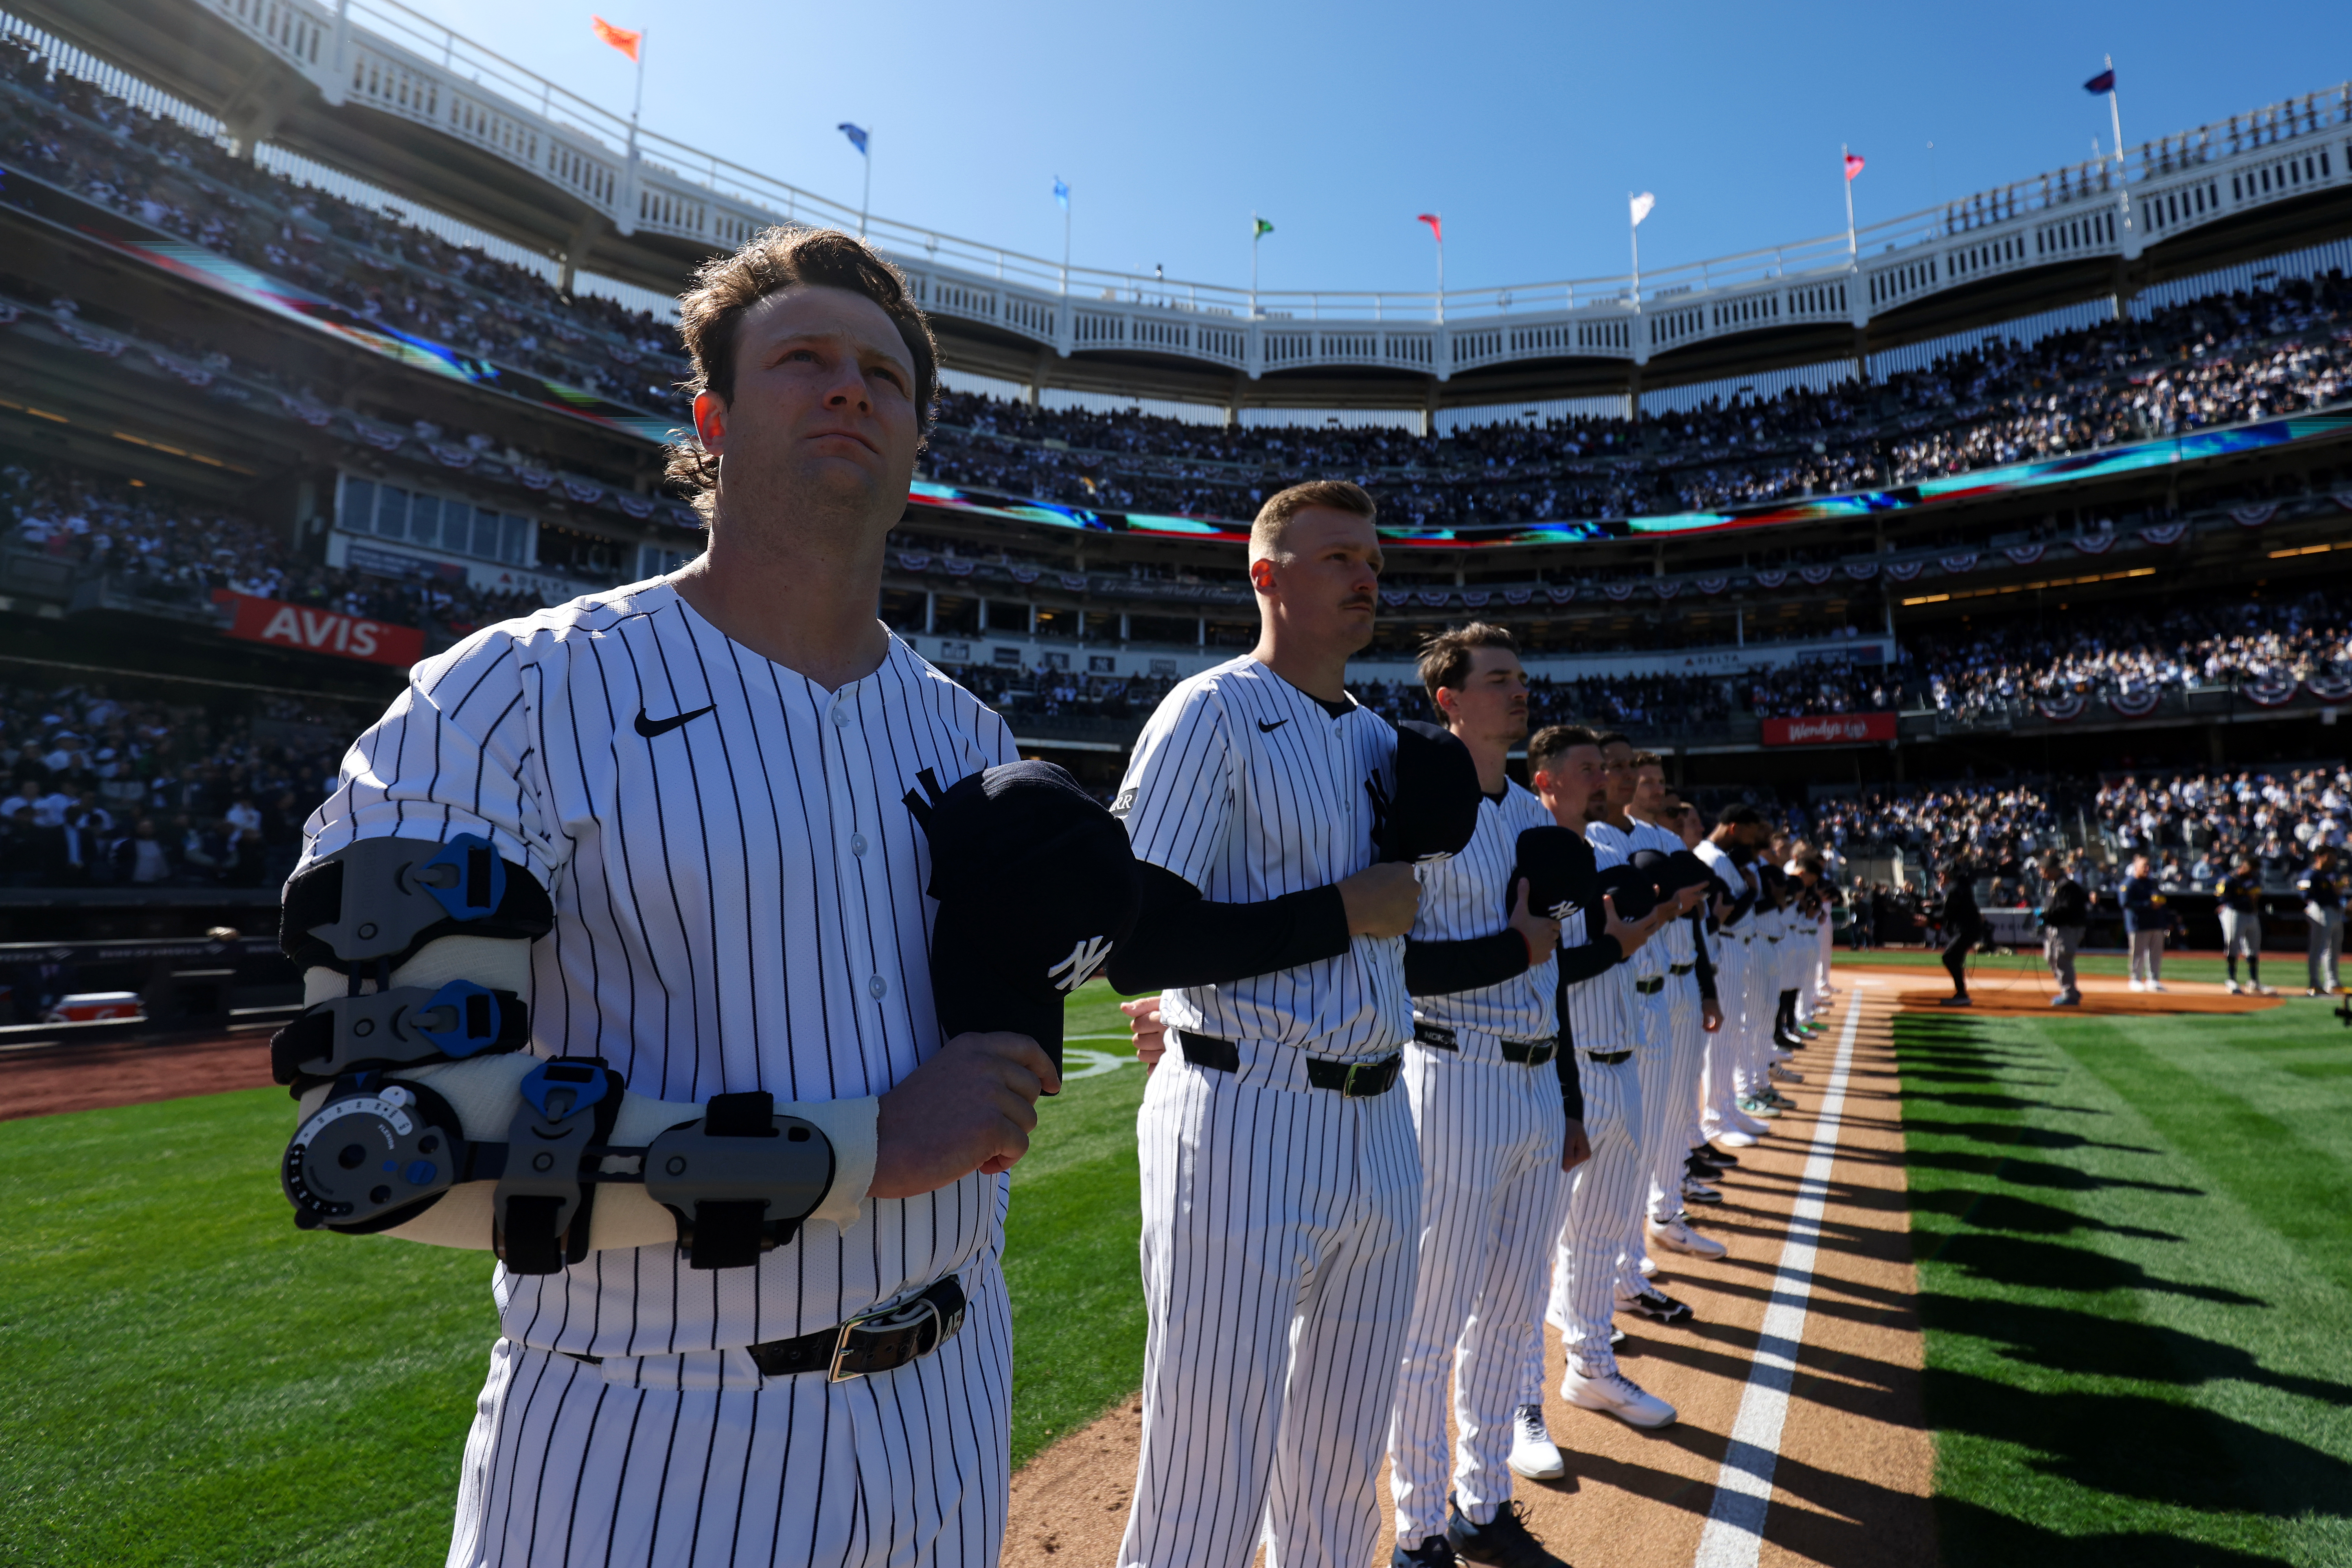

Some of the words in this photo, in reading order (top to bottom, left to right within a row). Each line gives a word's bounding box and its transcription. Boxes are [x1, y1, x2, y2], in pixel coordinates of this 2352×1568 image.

[262, 607, 379, 656] AVIS
[1048, 935, 1113, 990] NY
[940, 1307, 962, 1344] 45
